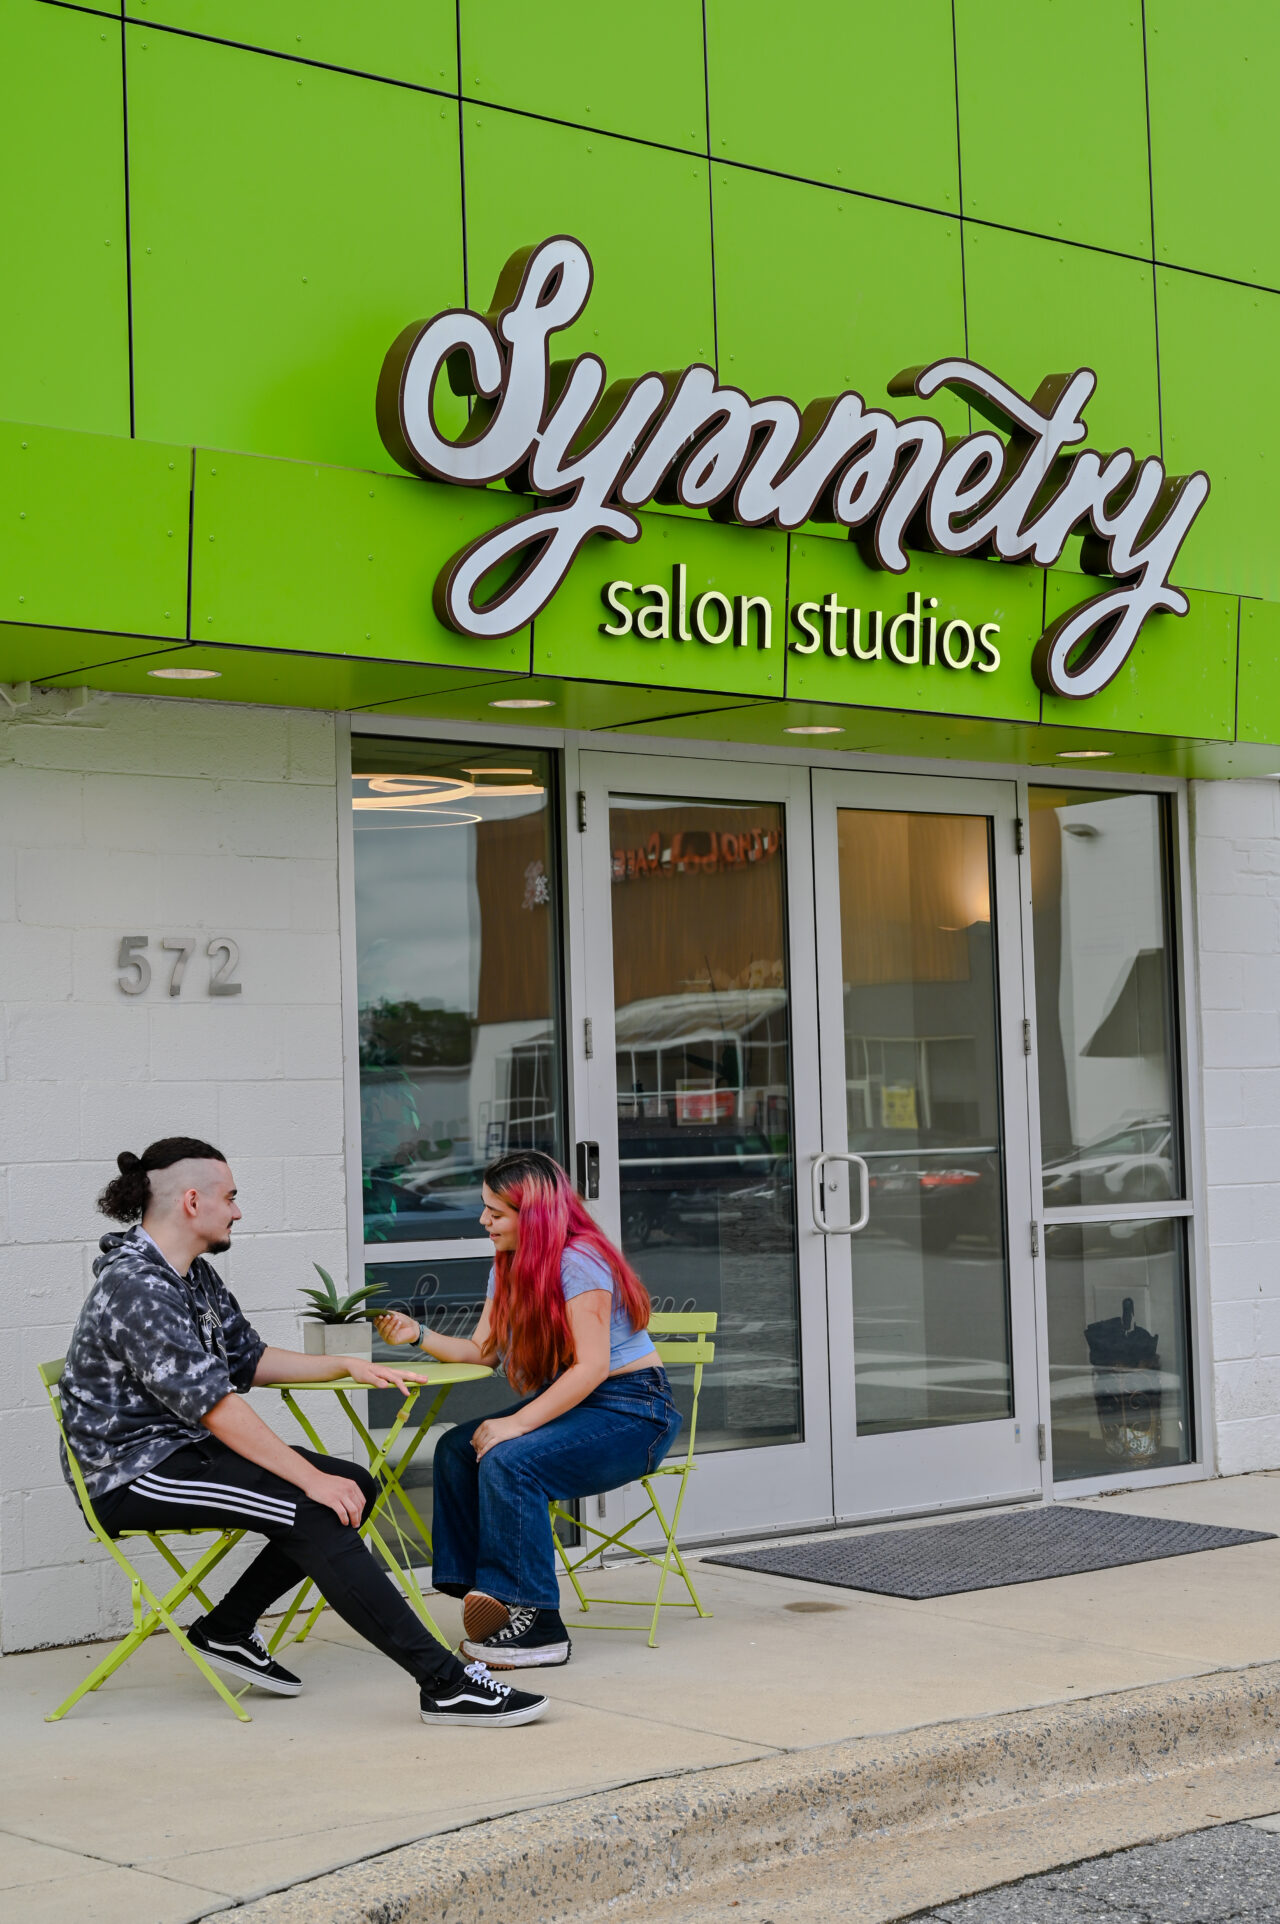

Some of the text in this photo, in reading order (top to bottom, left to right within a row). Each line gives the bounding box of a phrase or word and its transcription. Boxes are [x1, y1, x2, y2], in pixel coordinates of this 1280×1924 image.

[378, 234, 1211, 699] Symmetry
[598, 563, 1001, 673] salon studios
[118, 935, 242, 996] 572
